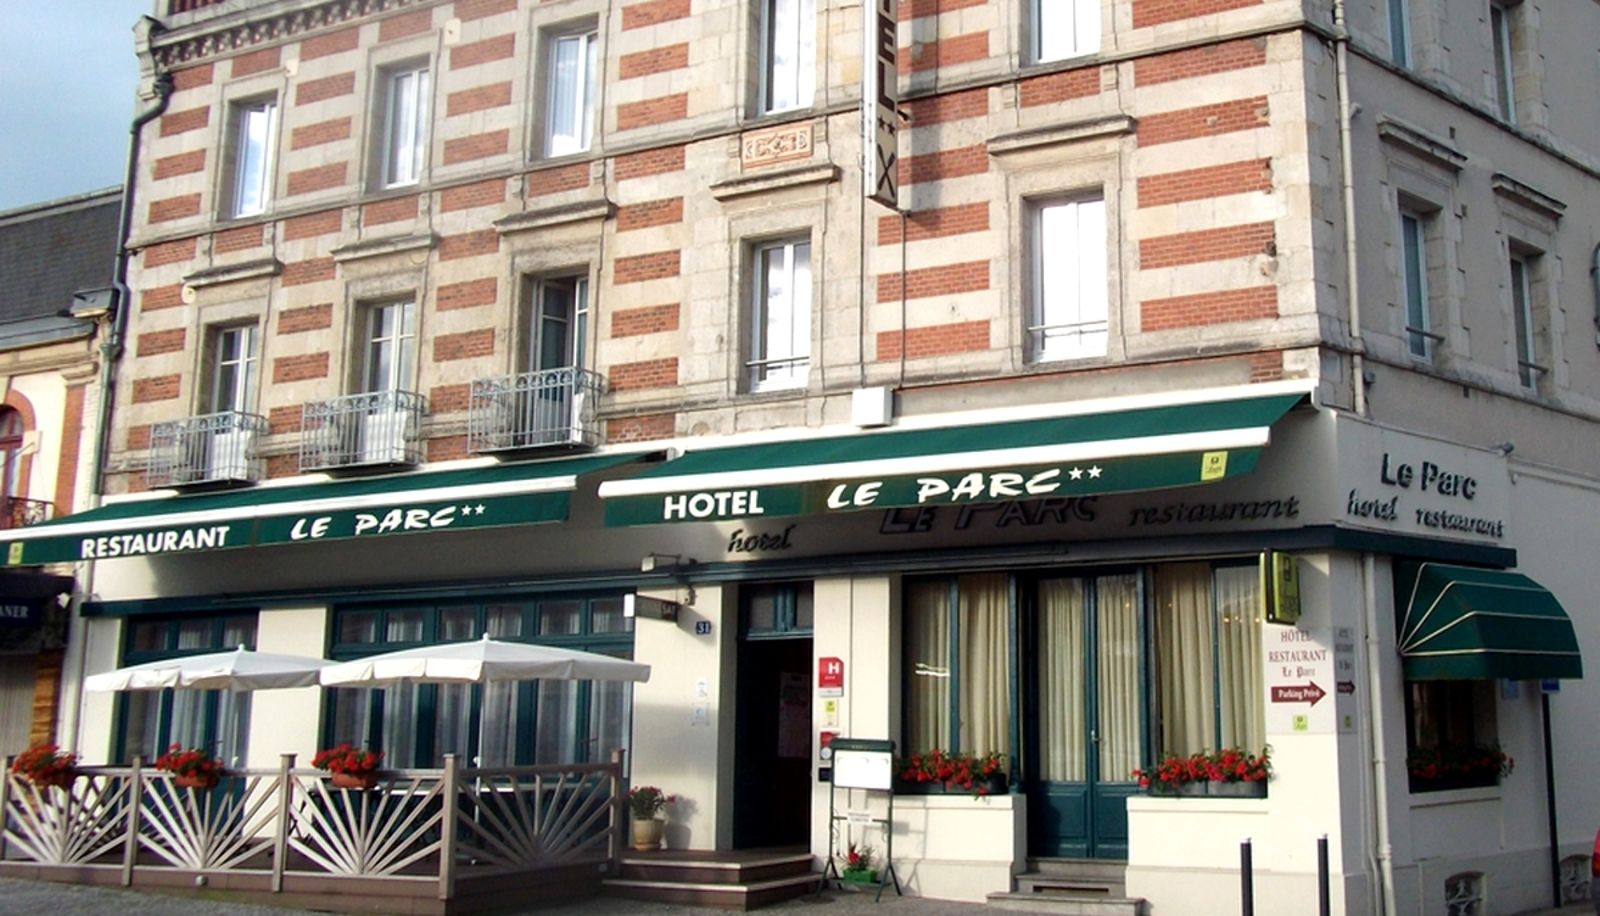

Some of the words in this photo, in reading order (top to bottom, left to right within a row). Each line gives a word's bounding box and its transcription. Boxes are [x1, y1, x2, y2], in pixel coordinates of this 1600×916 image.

[878, 0, 896, 112] EL
[826, 481, 884, 510] LE
[917, 470, 1061, 503] PARC
[1381, 452, 1413, 489] Le
[1421, 460, 1477, 501] Parc
[290, 516, 332, 541] LE
[354, 504, 457, 536] PARC
[663, 490, 765, 520] HOTEL
[1347, 488, 1399, 521] hotel
[1416, 507, 1504, 539] restaurant
[727, 524, 794, 553] hotel
[1129, 495, 1299, 527] restaurant
[81, 525, 230, 559] RESTAURANT
[698, 623, 710, 633] 31
[828, 662, 839, 674] H
[1268, 650, 1327, 662] RESTAURANT
[1278, 689, 1303, 700] Parking
